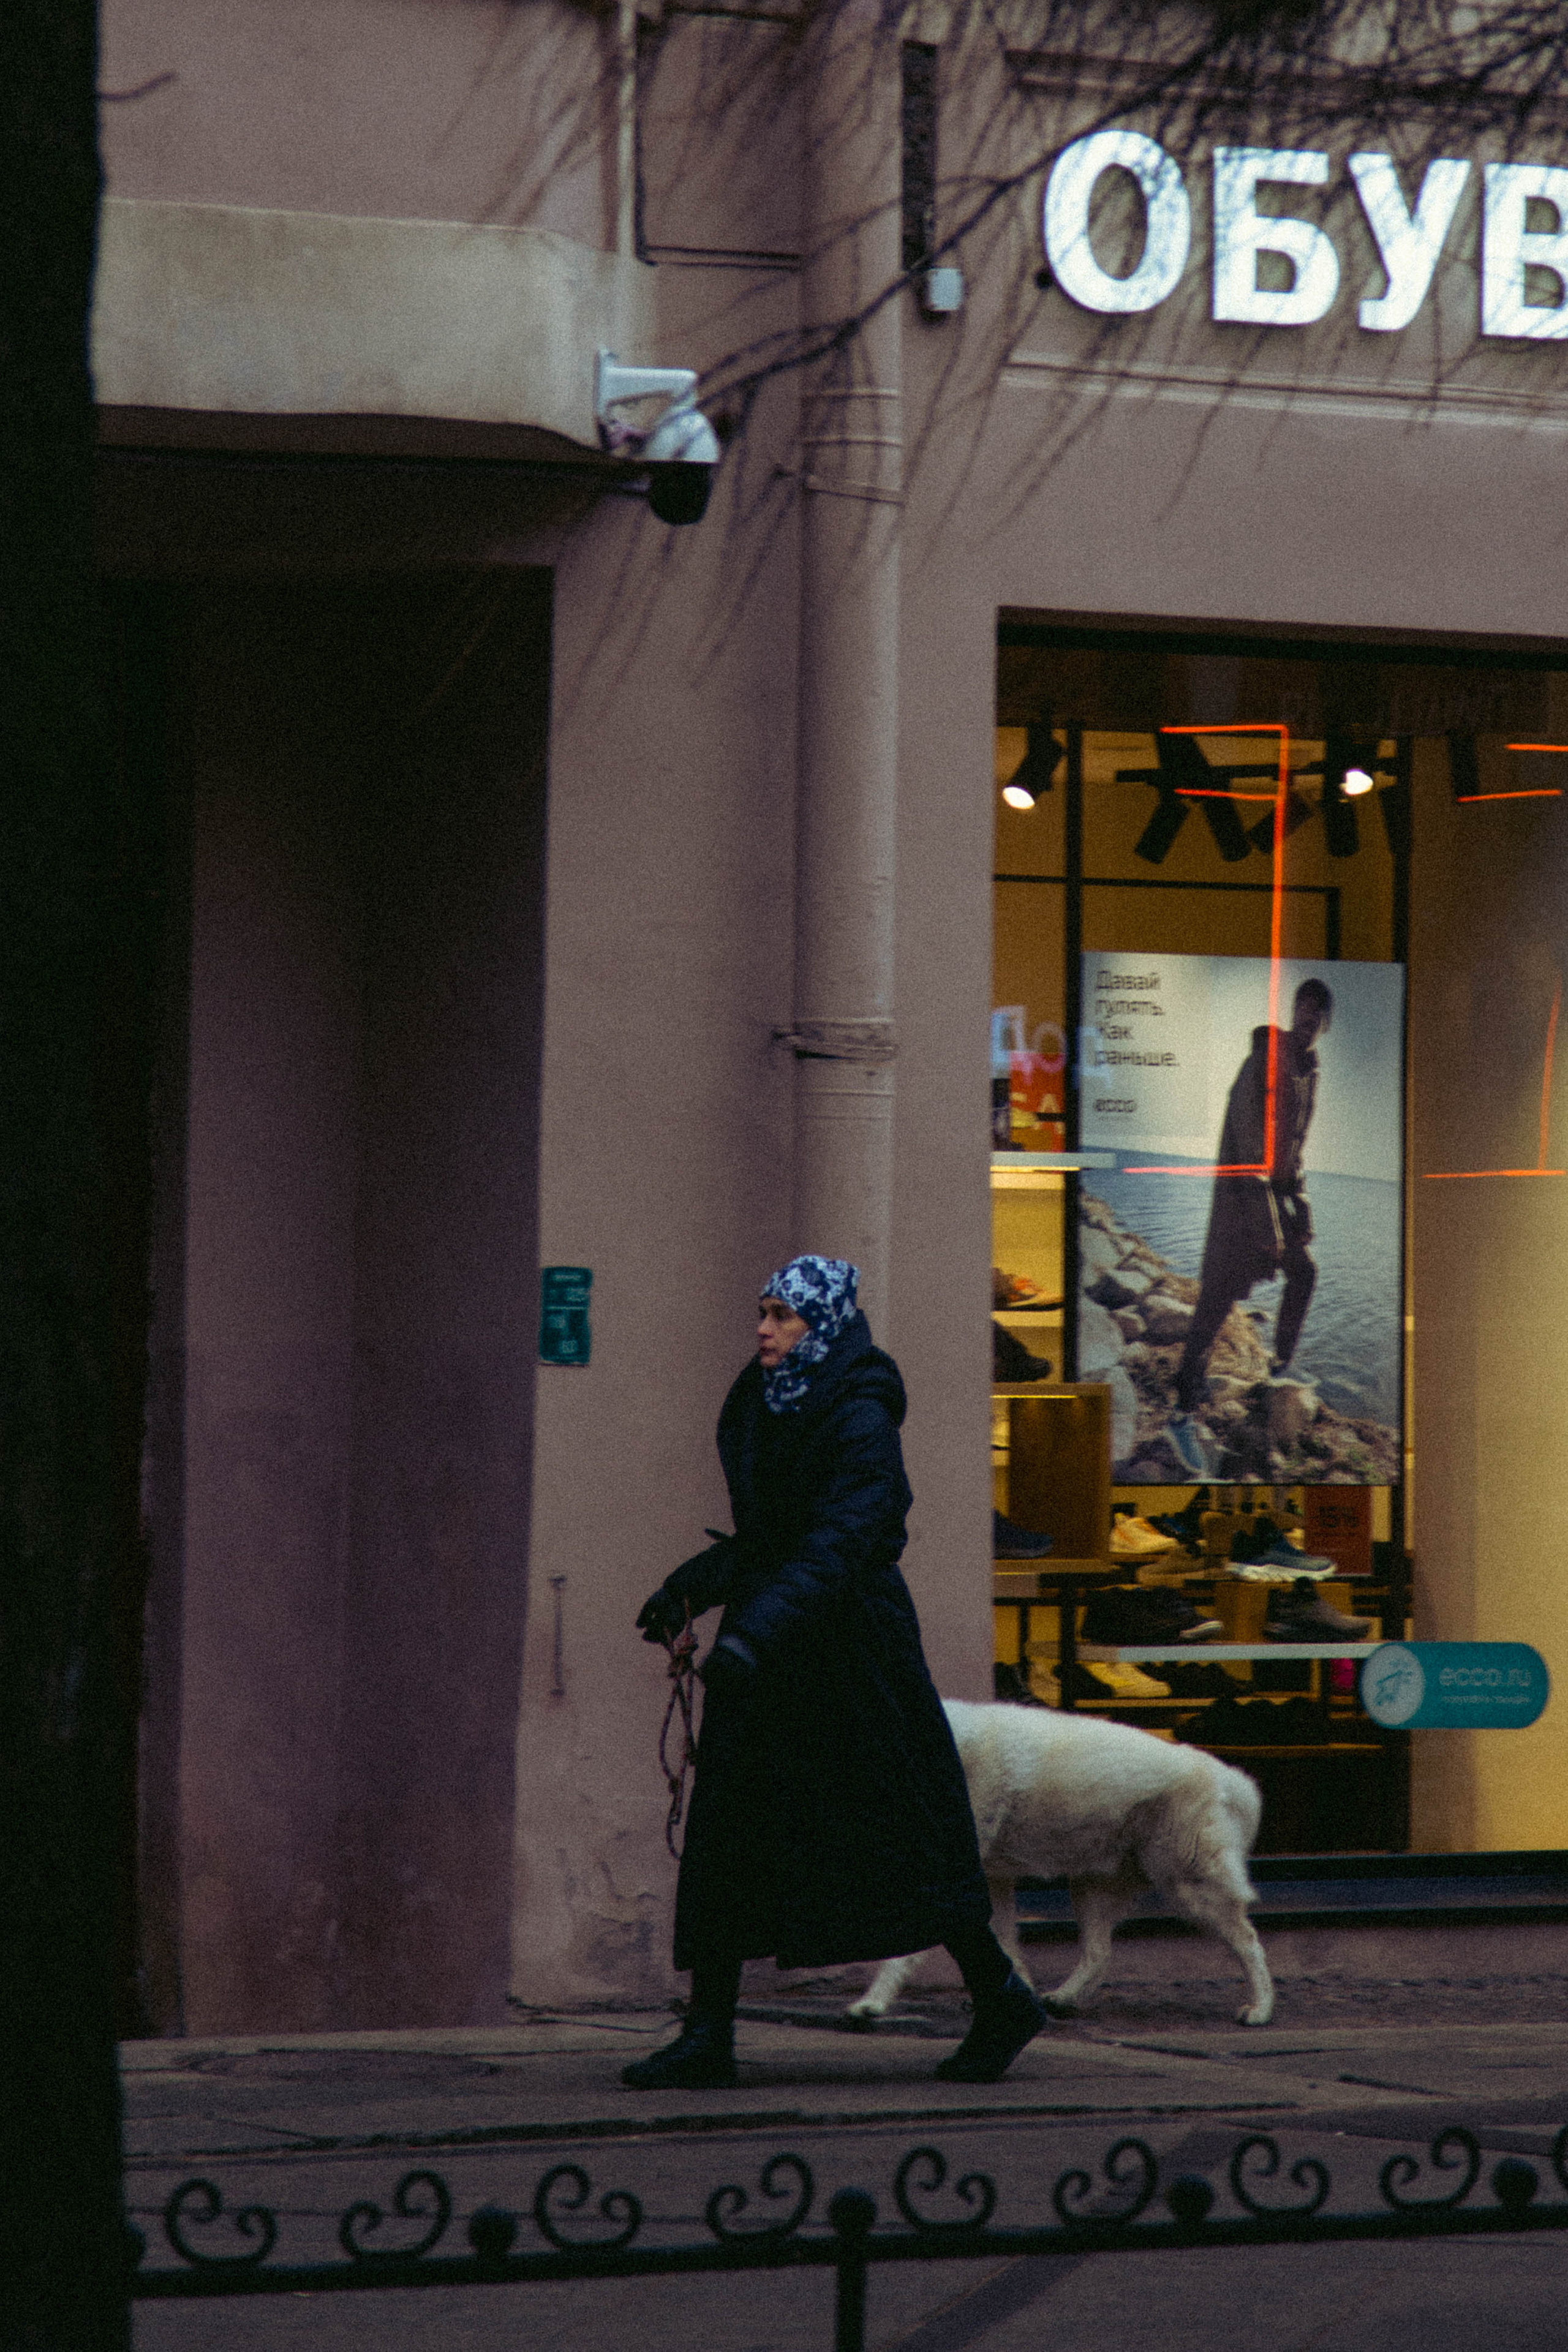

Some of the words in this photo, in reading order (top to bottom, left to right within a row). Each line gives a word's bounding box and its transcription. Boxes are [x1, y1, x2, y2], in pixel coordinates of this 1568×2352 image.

[1044, 129, 1568, 340] ОБУВ
[1095, 970, 1161, 992] Давай
[1093, 1099, 1137, 1113] ecco
[1438, 1667, 1532, 1687] ecco.ru
